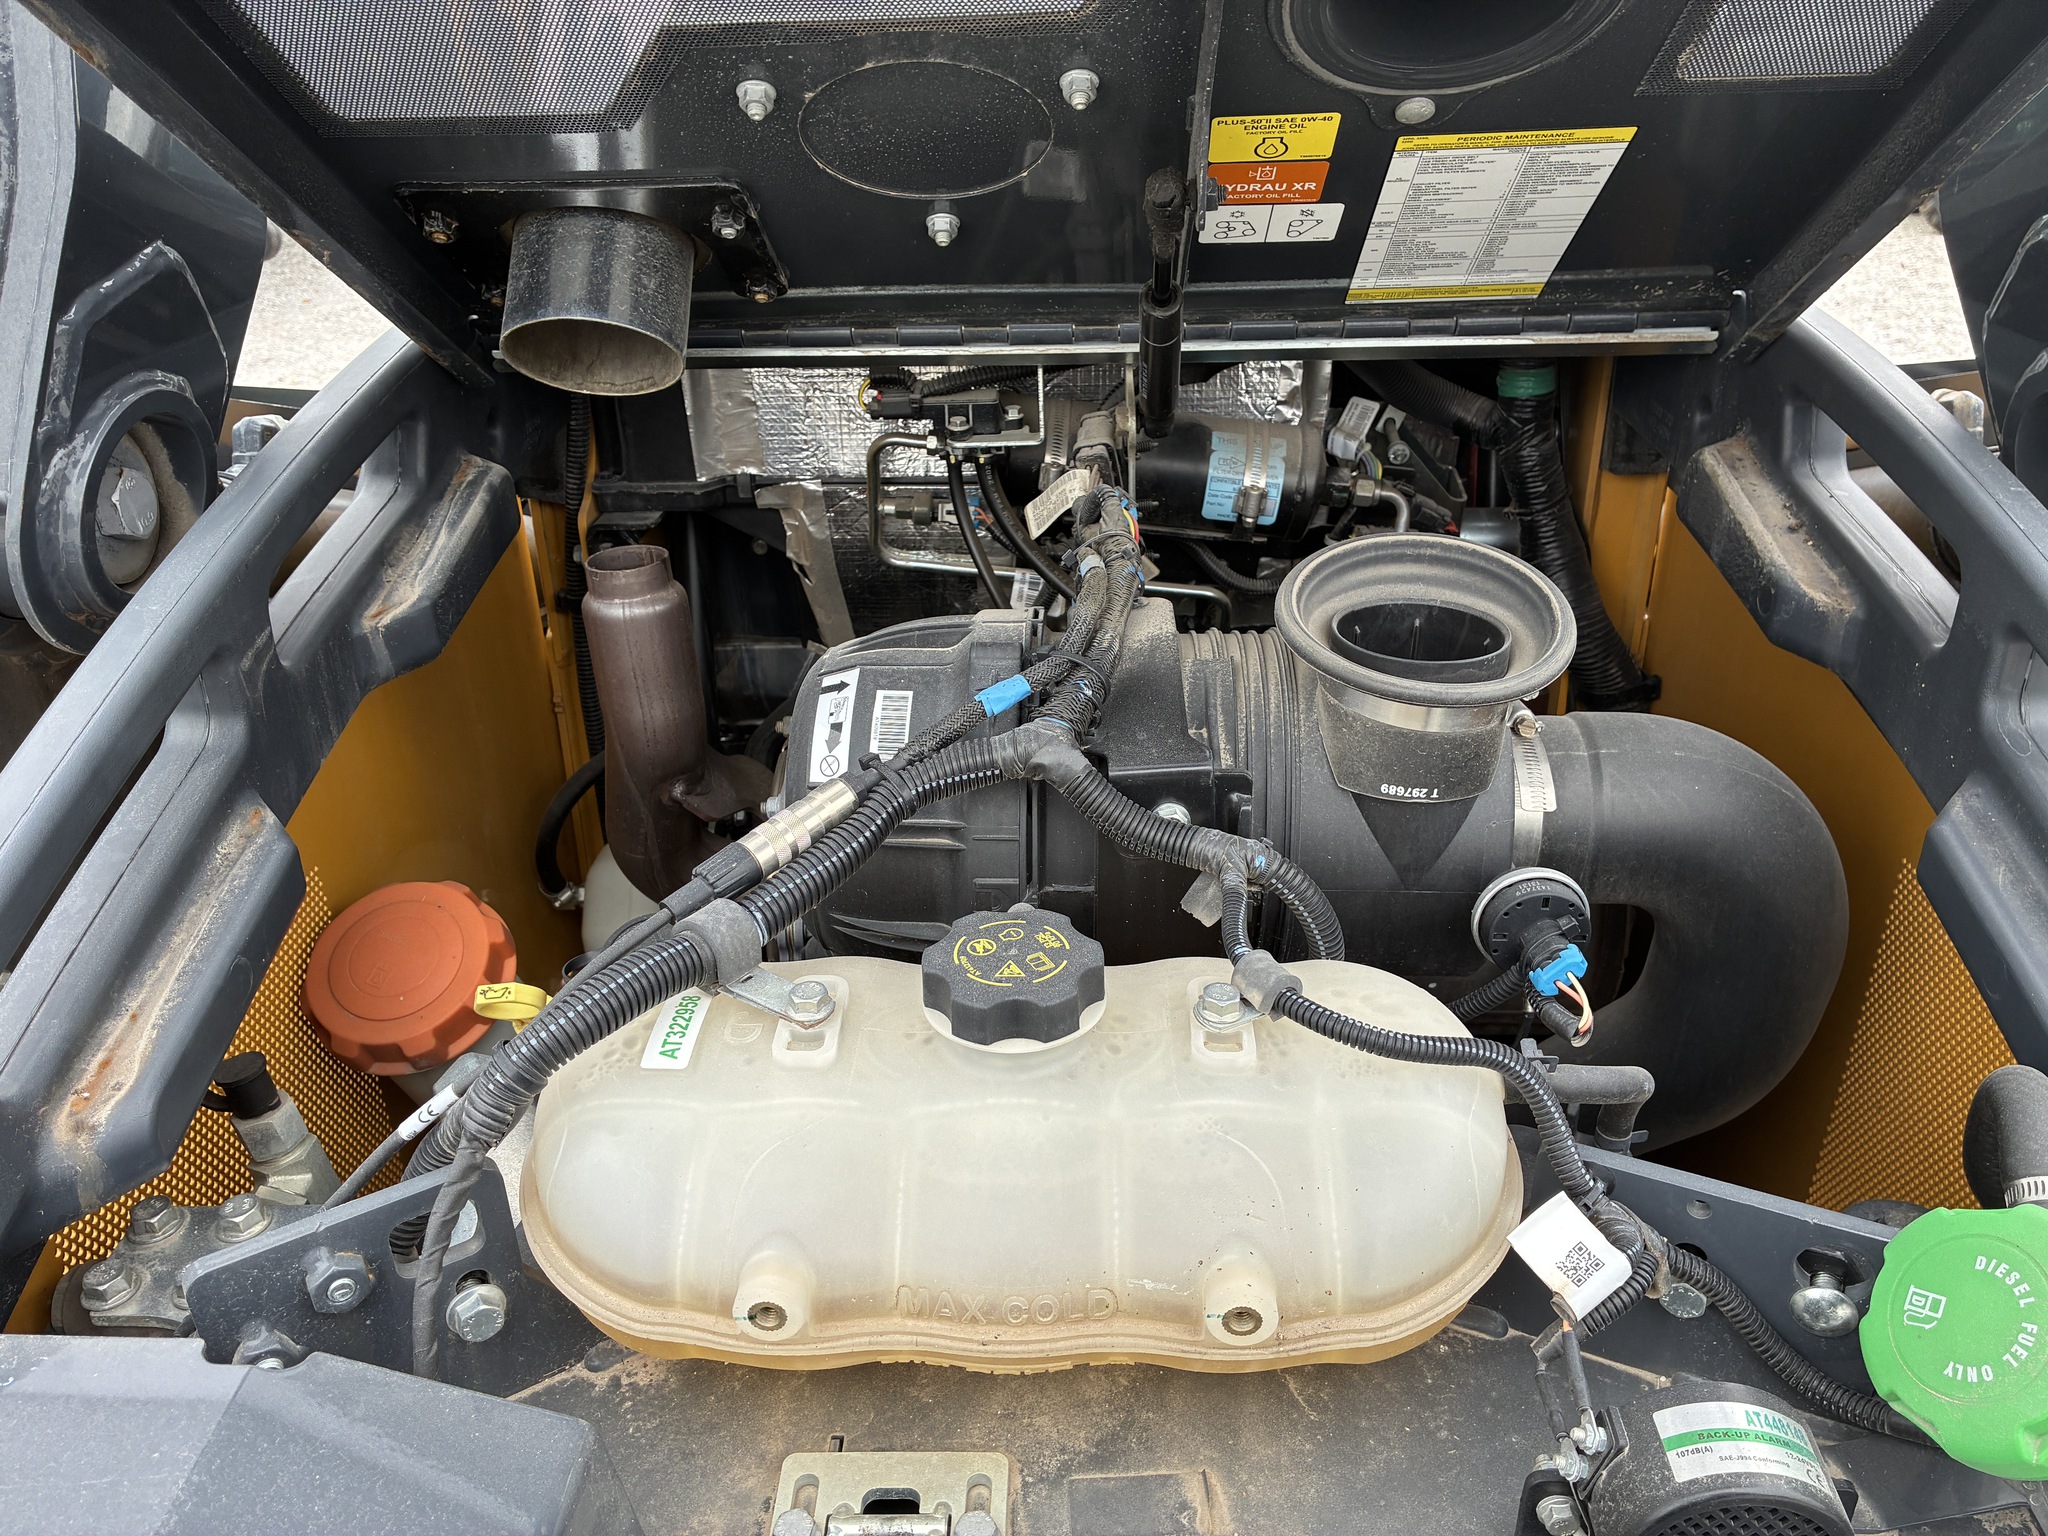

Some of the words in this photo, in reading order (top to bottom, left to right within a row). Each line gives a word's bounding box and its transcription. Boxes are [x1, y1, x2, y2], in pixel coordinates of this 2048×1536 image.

[1504, 132, 1576, 140] MAINTENANCE
[1225, 182, 1287, 192] YDRAU
[1291, 182, 1317, 190] XR
[1216, 436, 1238, 446] THIS
[1380, 784, 1428, 798] 297689
[1430, 788, 1439, 798] T
[659, 996, 702, 1060] AT322958
[1974, 1255, 2036, 1308] DIESEL
[896, 1284, 986, 1325] MAX
[1002, 1288, 1118, 1326] COLD
[2002, 1322, 2038, 1368] FUEL
[1943, 1361, 1994, 1382] ONLY
[1698, 1432, 1750, 1440] BACK-UP
[1754, 1434, 1790, 1448] ALARM
[1675, 1446, 1714, 1459] 107dB(A)
[1752, 1455, 1791, 1468] Conforming
